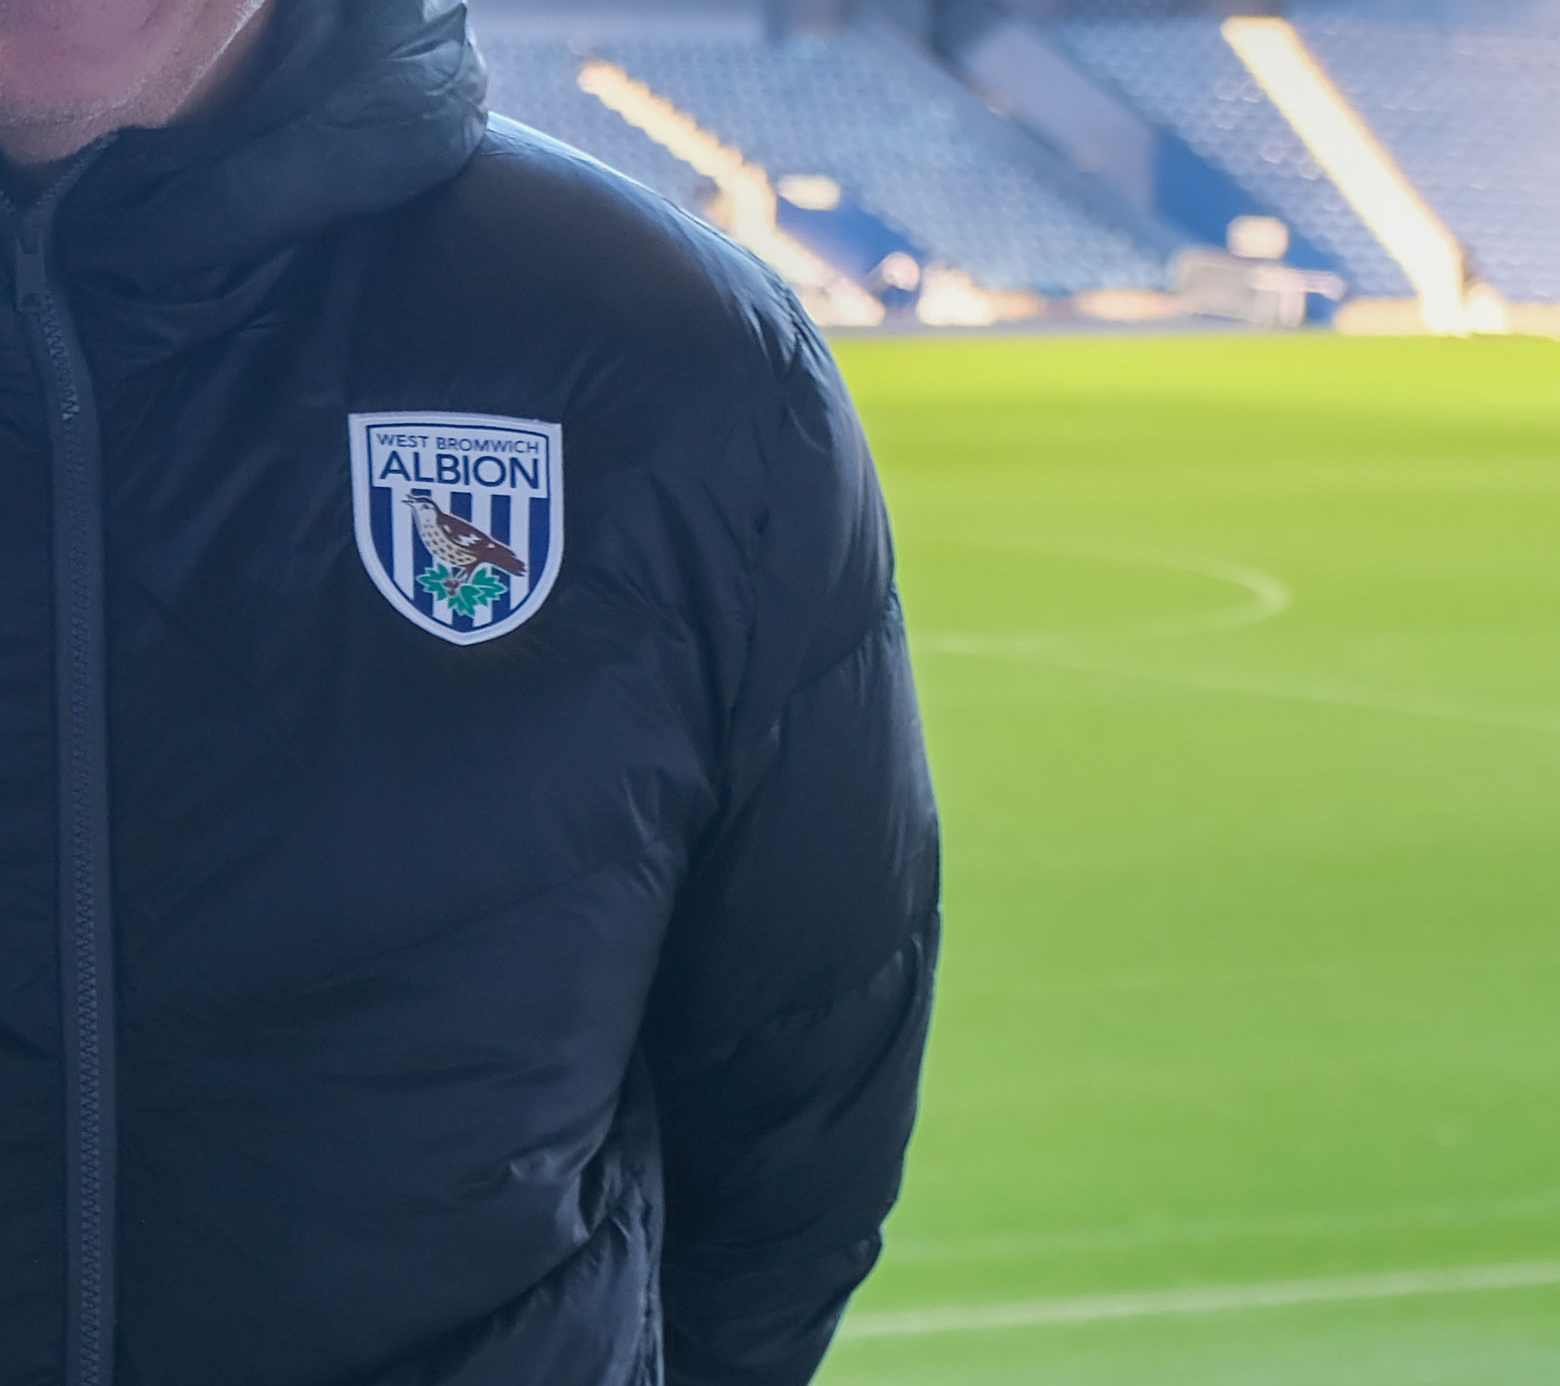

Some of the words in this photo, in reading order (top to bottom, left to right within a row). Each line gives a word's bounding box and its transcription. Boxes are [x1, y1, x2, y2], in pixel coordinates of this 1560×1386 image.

[377, 433, 428, 449] WEST
[436, 437, 538, 454] BROMWICH
[380, 451, 539, 489] ALBION
